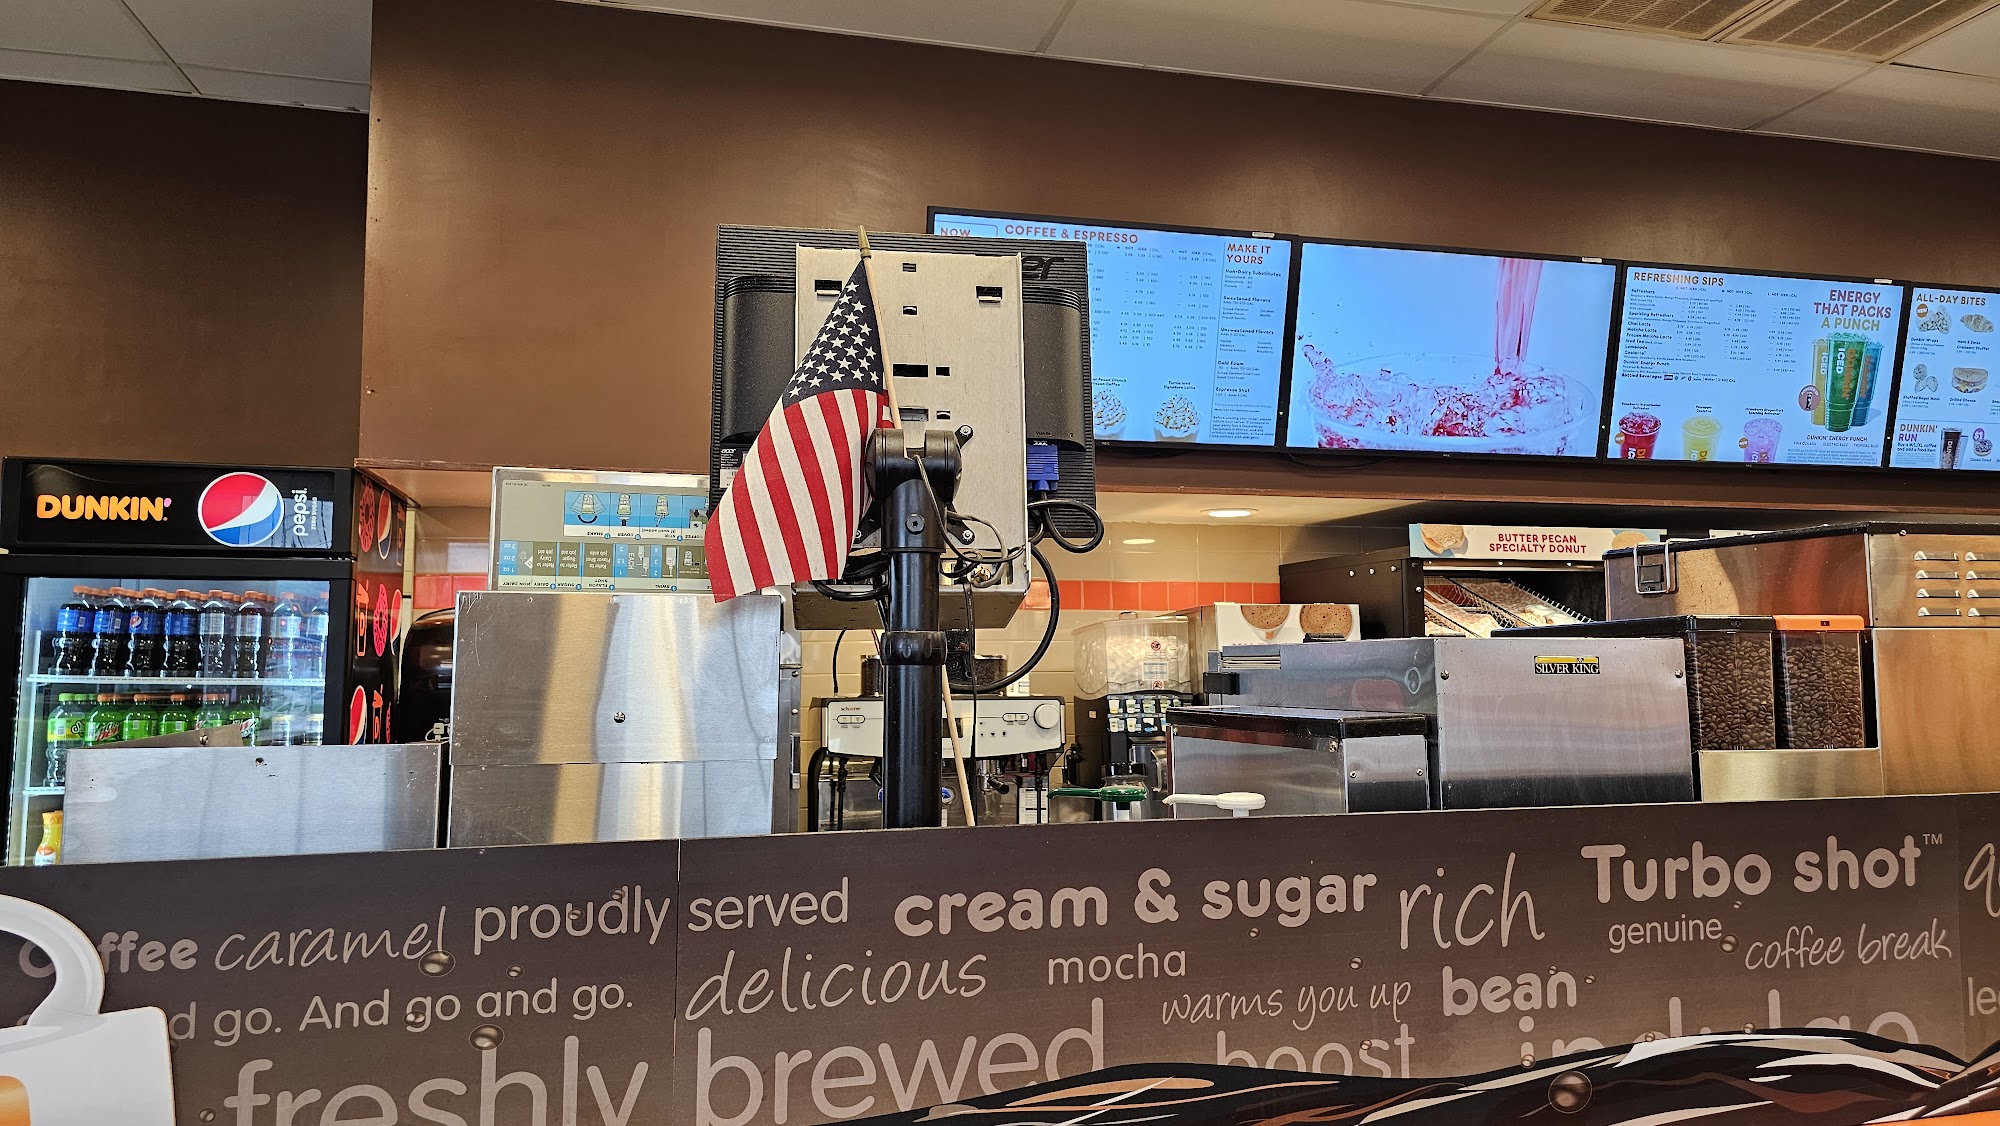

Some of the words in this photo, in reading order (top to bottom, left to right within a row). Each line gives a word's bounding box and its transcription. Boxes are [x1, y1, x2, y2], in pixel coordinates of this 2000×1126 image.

[940, 227, 971, 236] NOW
[1005, 224, 1057, 238] COFFEE
[1061, 228, 1070, 239] &
[1074, 230, 1138, 244] ESPRESSO
[1226, 254, 1263, 264] YOURS
[1227, 244, 1258, 253] MAKE
[1262, 246, 1271, 254] IT
[1634, 272, 1698, 284] REFRESHING
[1702, 277, 1724, 286] SIPS
[1814, 302, 1848, 315] THAT
[1851, 304, 1891, 318] PACKS
[1829, 290, 1880, 304] ENERGY
[1916, 294, 1958, 304] ALL-DAY
[1961, 296, 1986, 306] BITES
[1821, 316, 1830, 329] A
[1834, 317, 1880, 331] PUNCH
[1836, 348, 1845, 374] ICED
[1898, 433, 1918, 442] RUN
[1900, 424, 1938, 433] DUNKIN'
[36, 494, 172, 522] DUNKIN'
[292, 488, 310, 536] pepsi
[1489, 543, 1546, 552] SPECIALTY
[1549, 544, 1586, 553] DONUT
[1498, 534, 1539, 543] BUTTER
[1541, 534, 1577, 543] PECAN
[1536, 662, 1570, 674] SILVER
[1572, 662, 1599, 674] KING
[1580, 840, 1772, 903] Turbo
[474, 885, 671, 956] proudly
[687, 876, 848, 933] served
[894, 886, 1108, 938] cream
[1134, 868, 1179, 924] &
[1202, 872, 1378, 928] sugar
[1399, 852, 1545, 950] rich
[214, 905, 447, 971] caramel
[1608, 914, 1722, 954] genuine
[1745, 924, 1844, 971] coffee
[1858, 917, 1952, 966] break
[18, 930, 199, 978] cffee
[1048, 943, 1186, 986] mocha
[685, 946, 989, 1022] delicious
[1442, 966, 1577, 1017] bean
[214, 1008, 282, 1047] go.
[299, 988, 390, 1032] And
[406, 994, 461, 1032] go
[476, 977, 557, 1018] and
[572, 984, 633, 1020] go.
[1162, 988, 1284, 1025] warms
[1292, 984, 1358, 1031] you
[1370, 981, 1412, 1023] up
[698, 997, 1105, 1126] brewed
[223, 1035, 649, 1126] freshly
